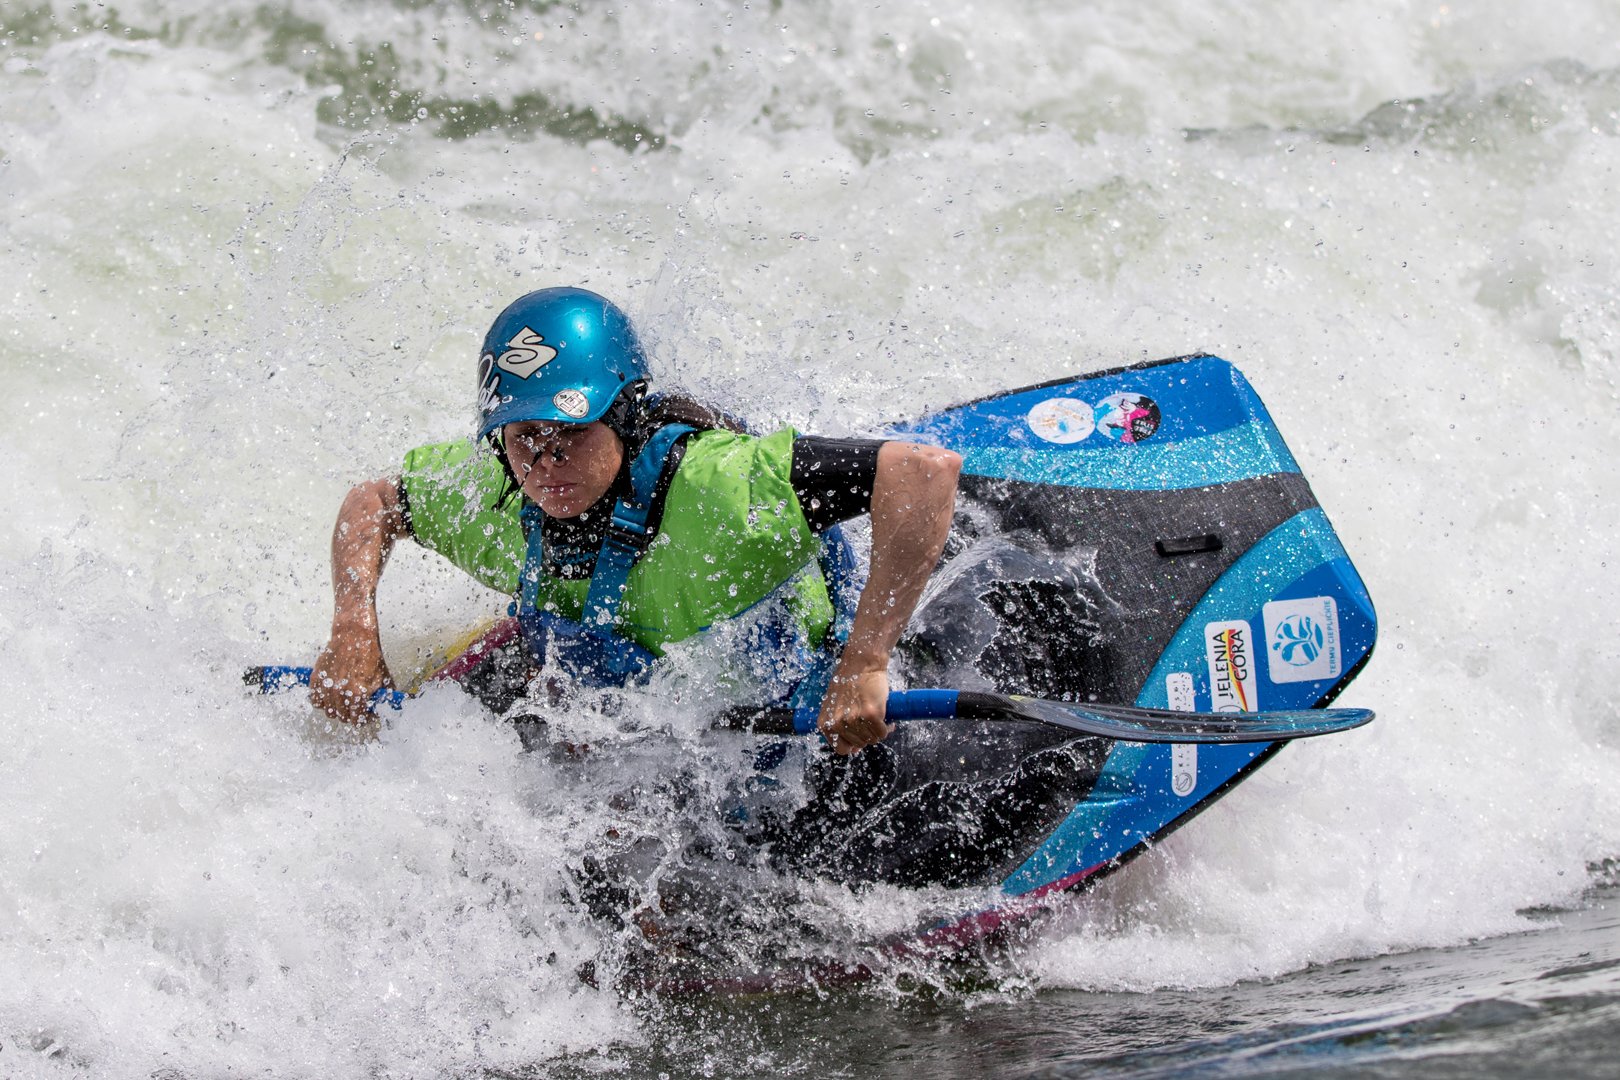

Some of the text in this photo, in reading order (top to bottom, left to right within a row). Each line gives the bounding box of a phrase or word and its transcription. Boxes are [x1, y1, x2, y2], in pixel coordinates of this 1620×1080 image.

[1324, 600, 1334, 644] CIEPLICKIE
[1212, 631, 1233, 699] JELENIA
[1229, 629, 1247, 681] GÓRA
